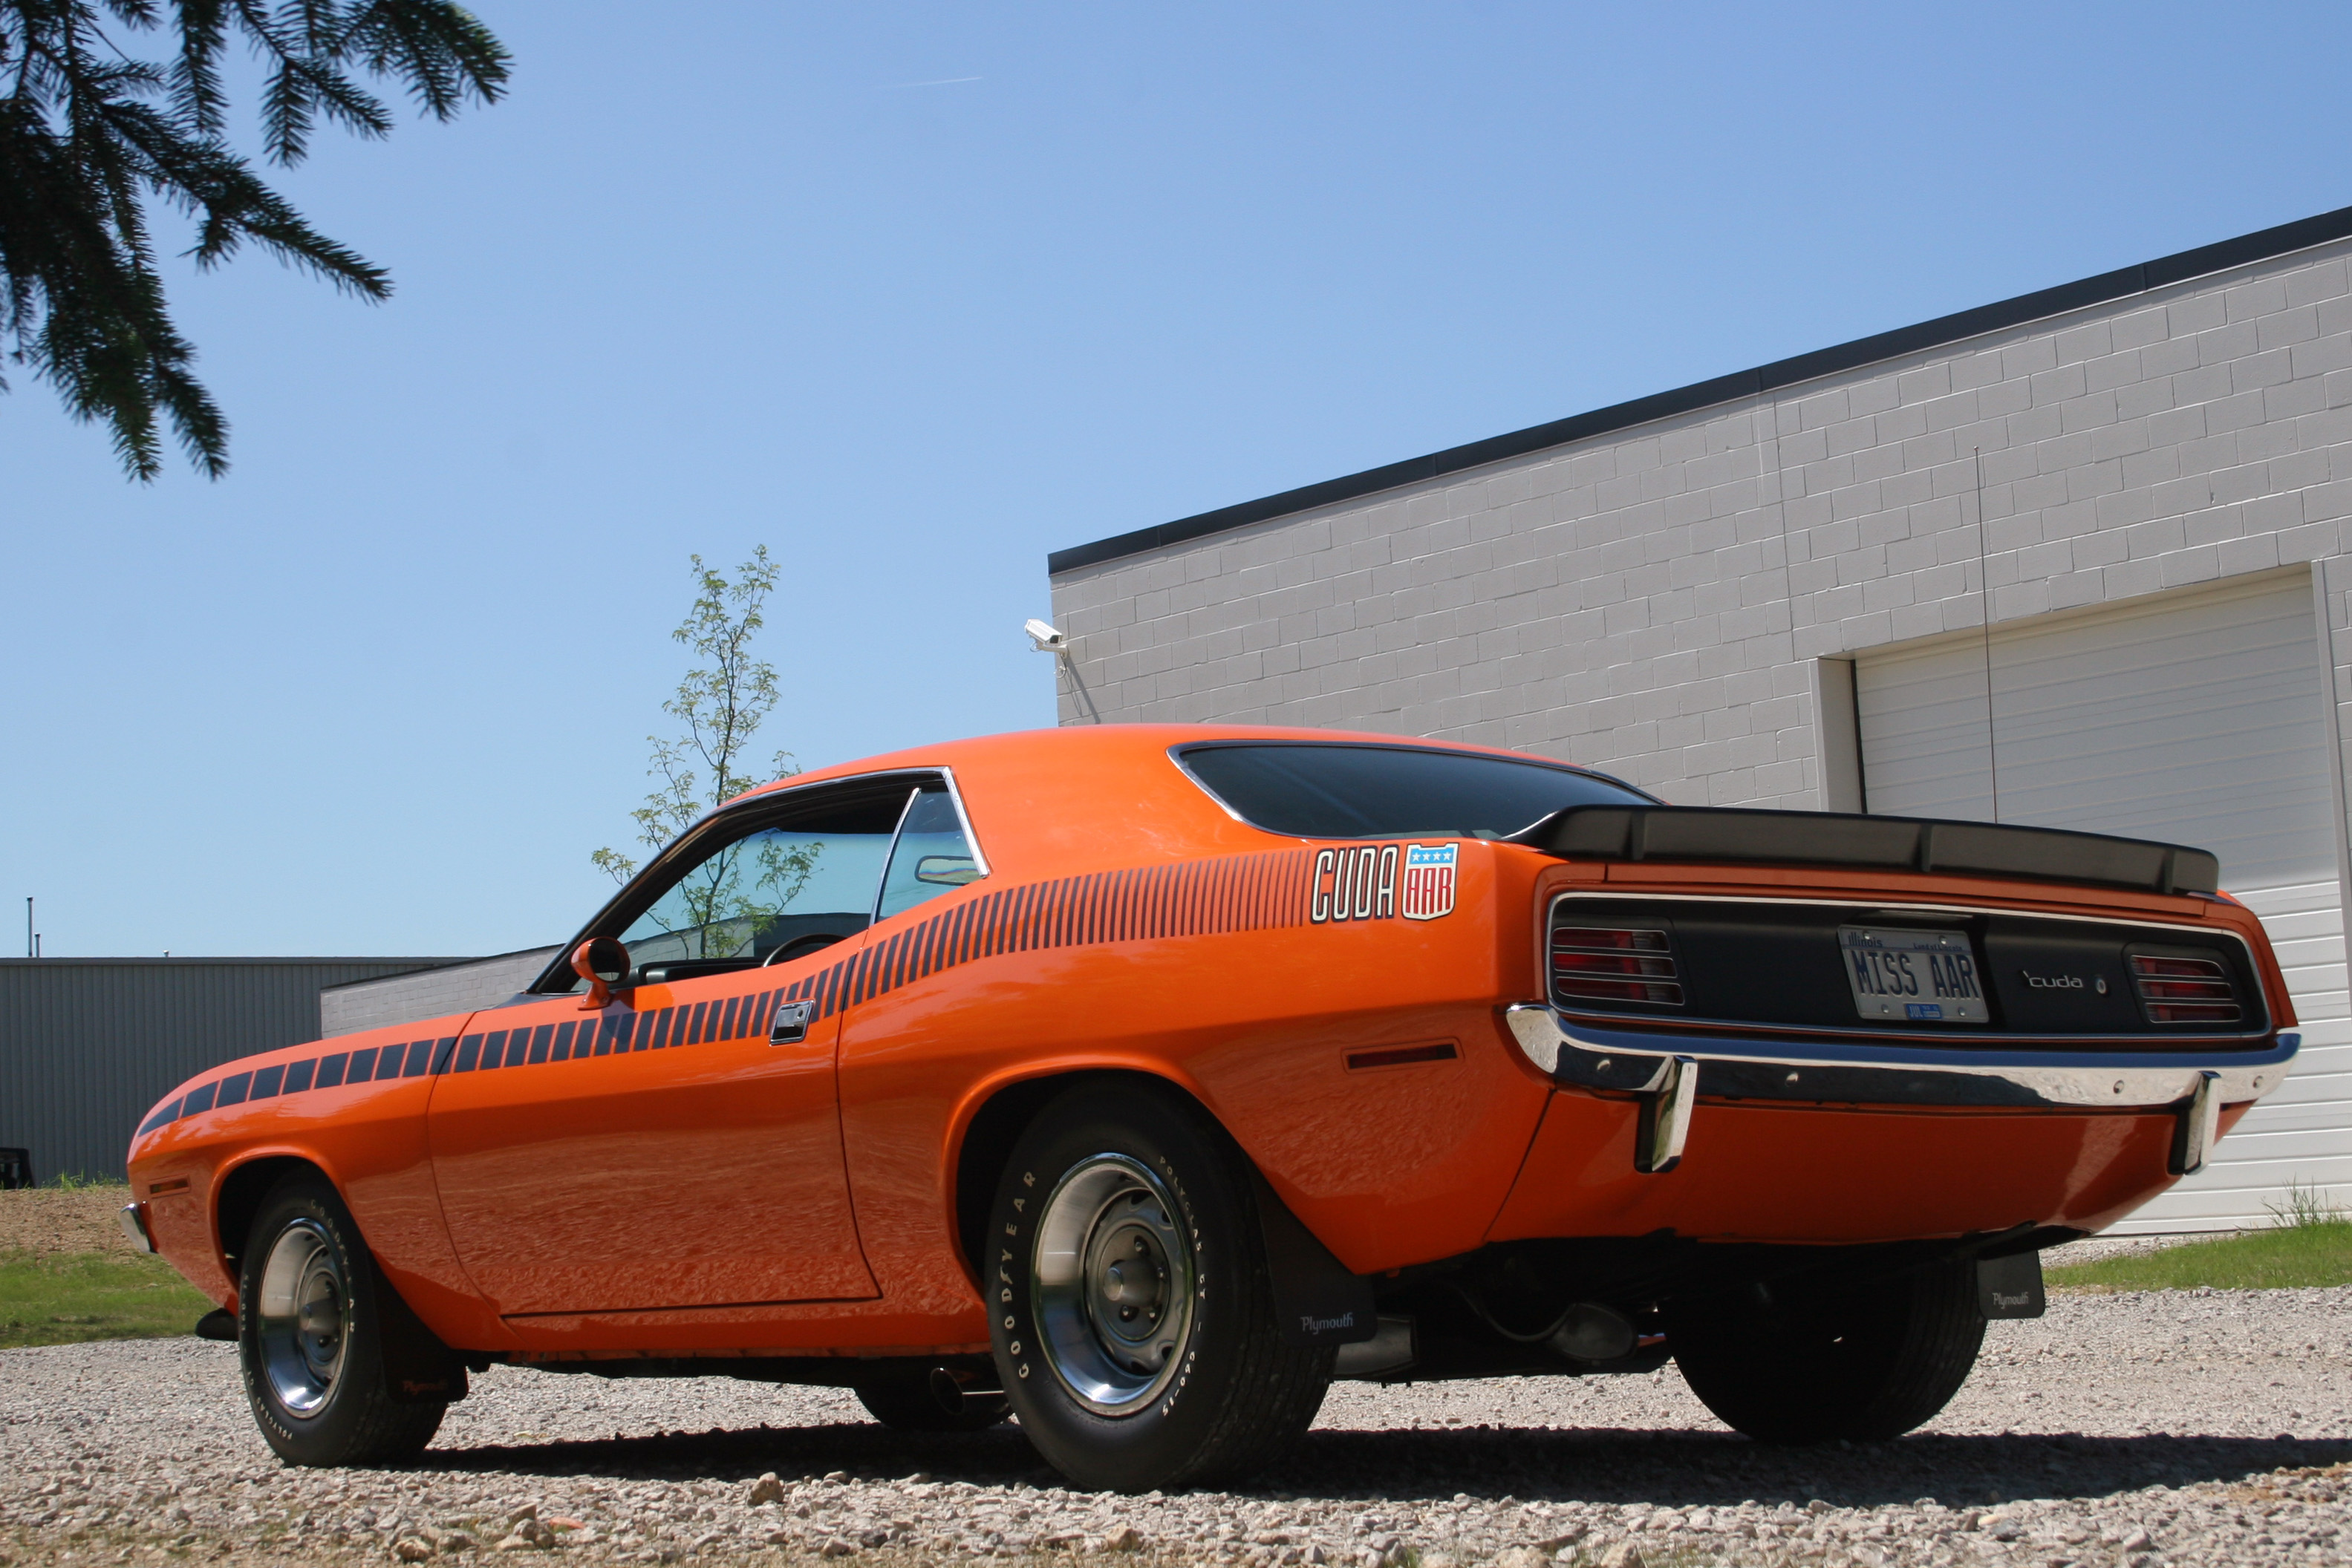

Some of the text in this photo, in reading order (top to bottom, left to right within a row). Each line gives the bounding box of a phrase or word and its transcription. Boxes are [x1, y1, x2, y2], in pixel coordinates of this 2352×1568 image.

[1310, 845, 1400, 924] CUDA
[1406, 867, 1453, 915] AAR
[1848, 932, 1883, 947] Illinois
[1851, 950, 1980, 999] MISS AAR
[1159, 1155, 1202, 1252] POLYGLAS
[1000, 1171, 1037, 1379] GOODYEAR
[1300, 1312, 1353, 1335] Plymouth
[1992, 1291, 2029, 1310] Plymouth
